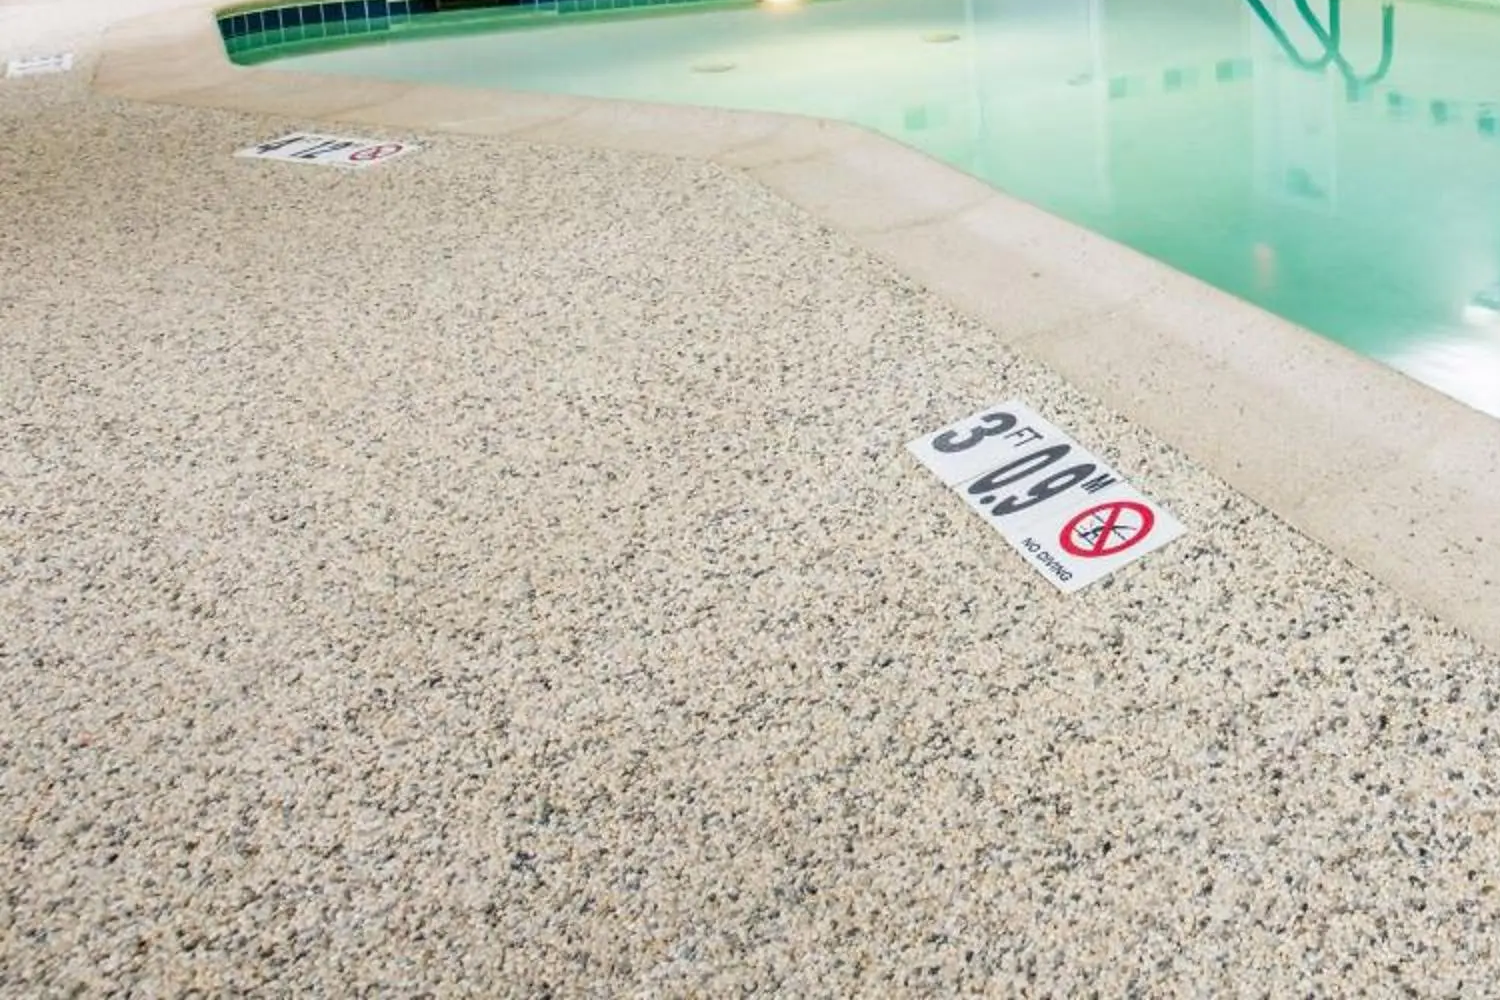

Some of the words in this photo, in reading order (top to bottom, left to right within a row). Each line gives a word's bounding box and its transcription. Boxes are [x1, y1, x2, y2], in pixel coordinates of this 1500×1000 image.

[931, 412, 1017, 453] 3
[1004, 426, 1044, 447] FT
[967, 443, 1097, 517] 0.9
[1021, 537, 1041, 553] NO
[1036, 551, 1073, 582] DIVING
